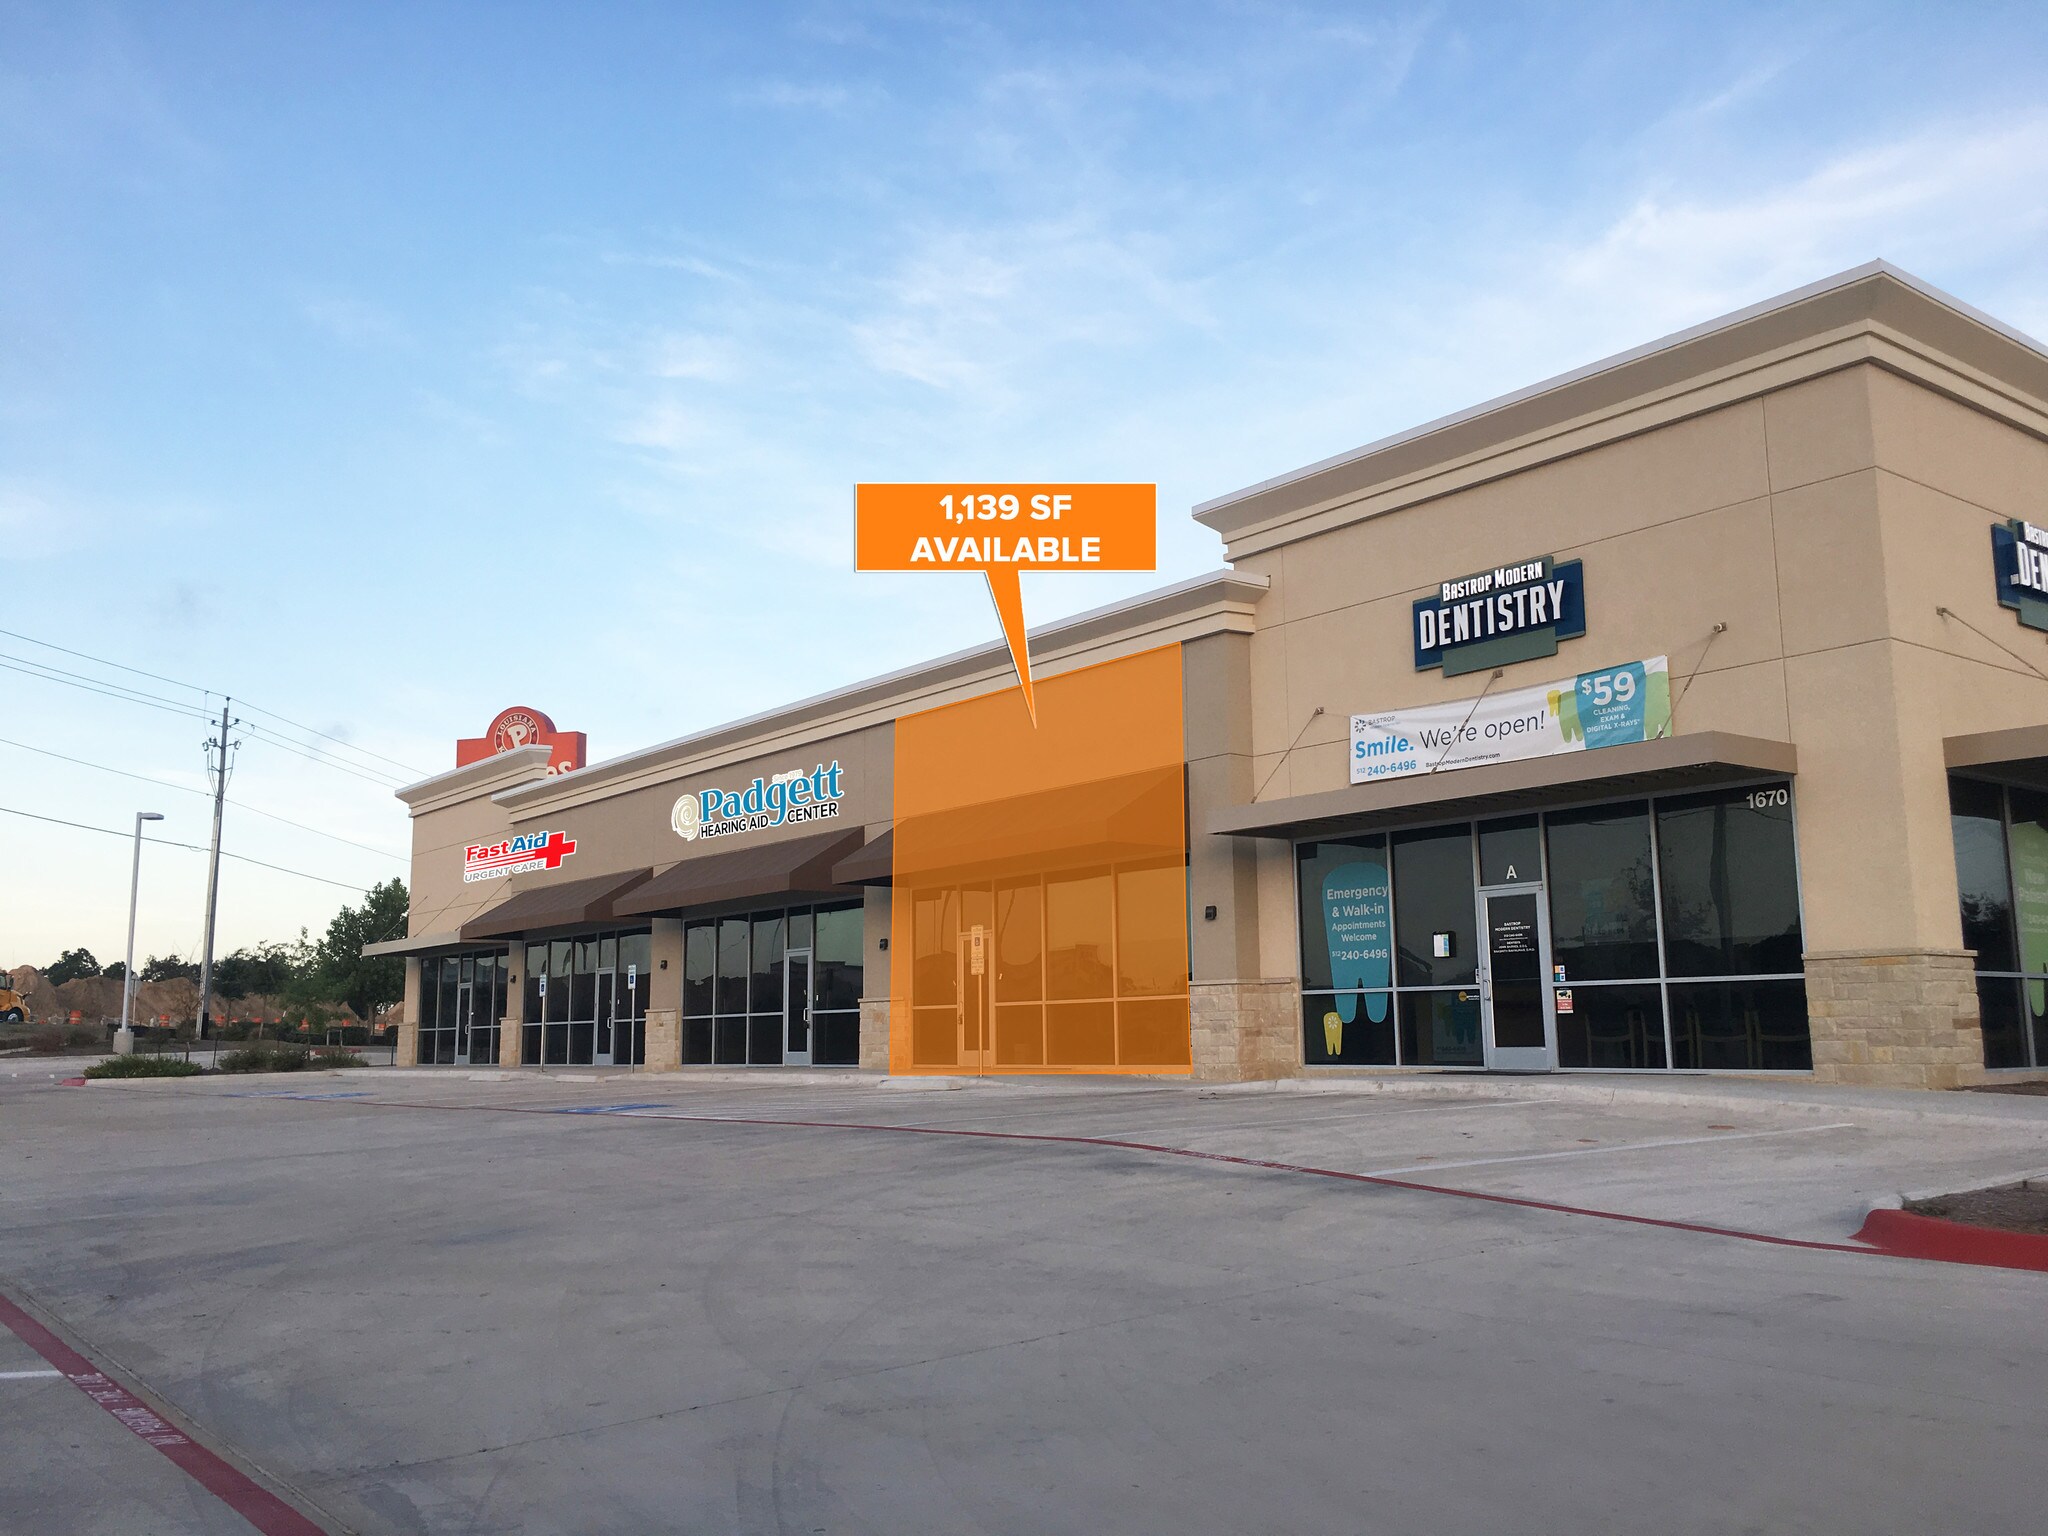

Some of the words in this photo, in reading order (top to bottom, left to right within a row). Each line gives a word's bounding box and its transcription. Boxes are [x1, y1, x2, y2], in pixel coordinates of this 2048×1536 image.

[1442, 574, 1492, 602] BASTROP
[1494, 561, 1543, 588] MODERN
[1419, 580, 1564, 650] DENTISTRY
[1581, 671, 1636, 706] $59
[1593, 705, 1631, 716] CLEANING,
[1600, 714, 1619, 723] EXAM
[497, 714, 537, 736] LOUISIANA
[1485, 710, 1544, 741] open!
[1586, 724, 1612, 733] DIGITAL
[1355, 735, 1414, 759] Smile.
[1367, 760, 1417, 776] 240-6496
[700, 761, 843, 825] Padgett
[1746, 789, 1788, 809] 1670
[700, 819, 746, 838] HEARING
[749, 815, 769, 830] AID
[787, 802, 838, 823] CENTER
[465, 841, 509, 861] Fast
[511, 832, 548, 853] Aid
[464, 866, 511, 882] URGENT
[512, 860, 544, 873] CARE
[1506, 864, 1517, 879] A
[1327, 886, 1388, 900] Emergency
[1332, 906, 1340, 917] &
[1343, 903, 1384, 917] Walk-in
[1332, 920, 1386, 932] Appointments
[1341, 933, 1377, 942] Welcome
[1341, 949, 1388, 960] 240-6496
